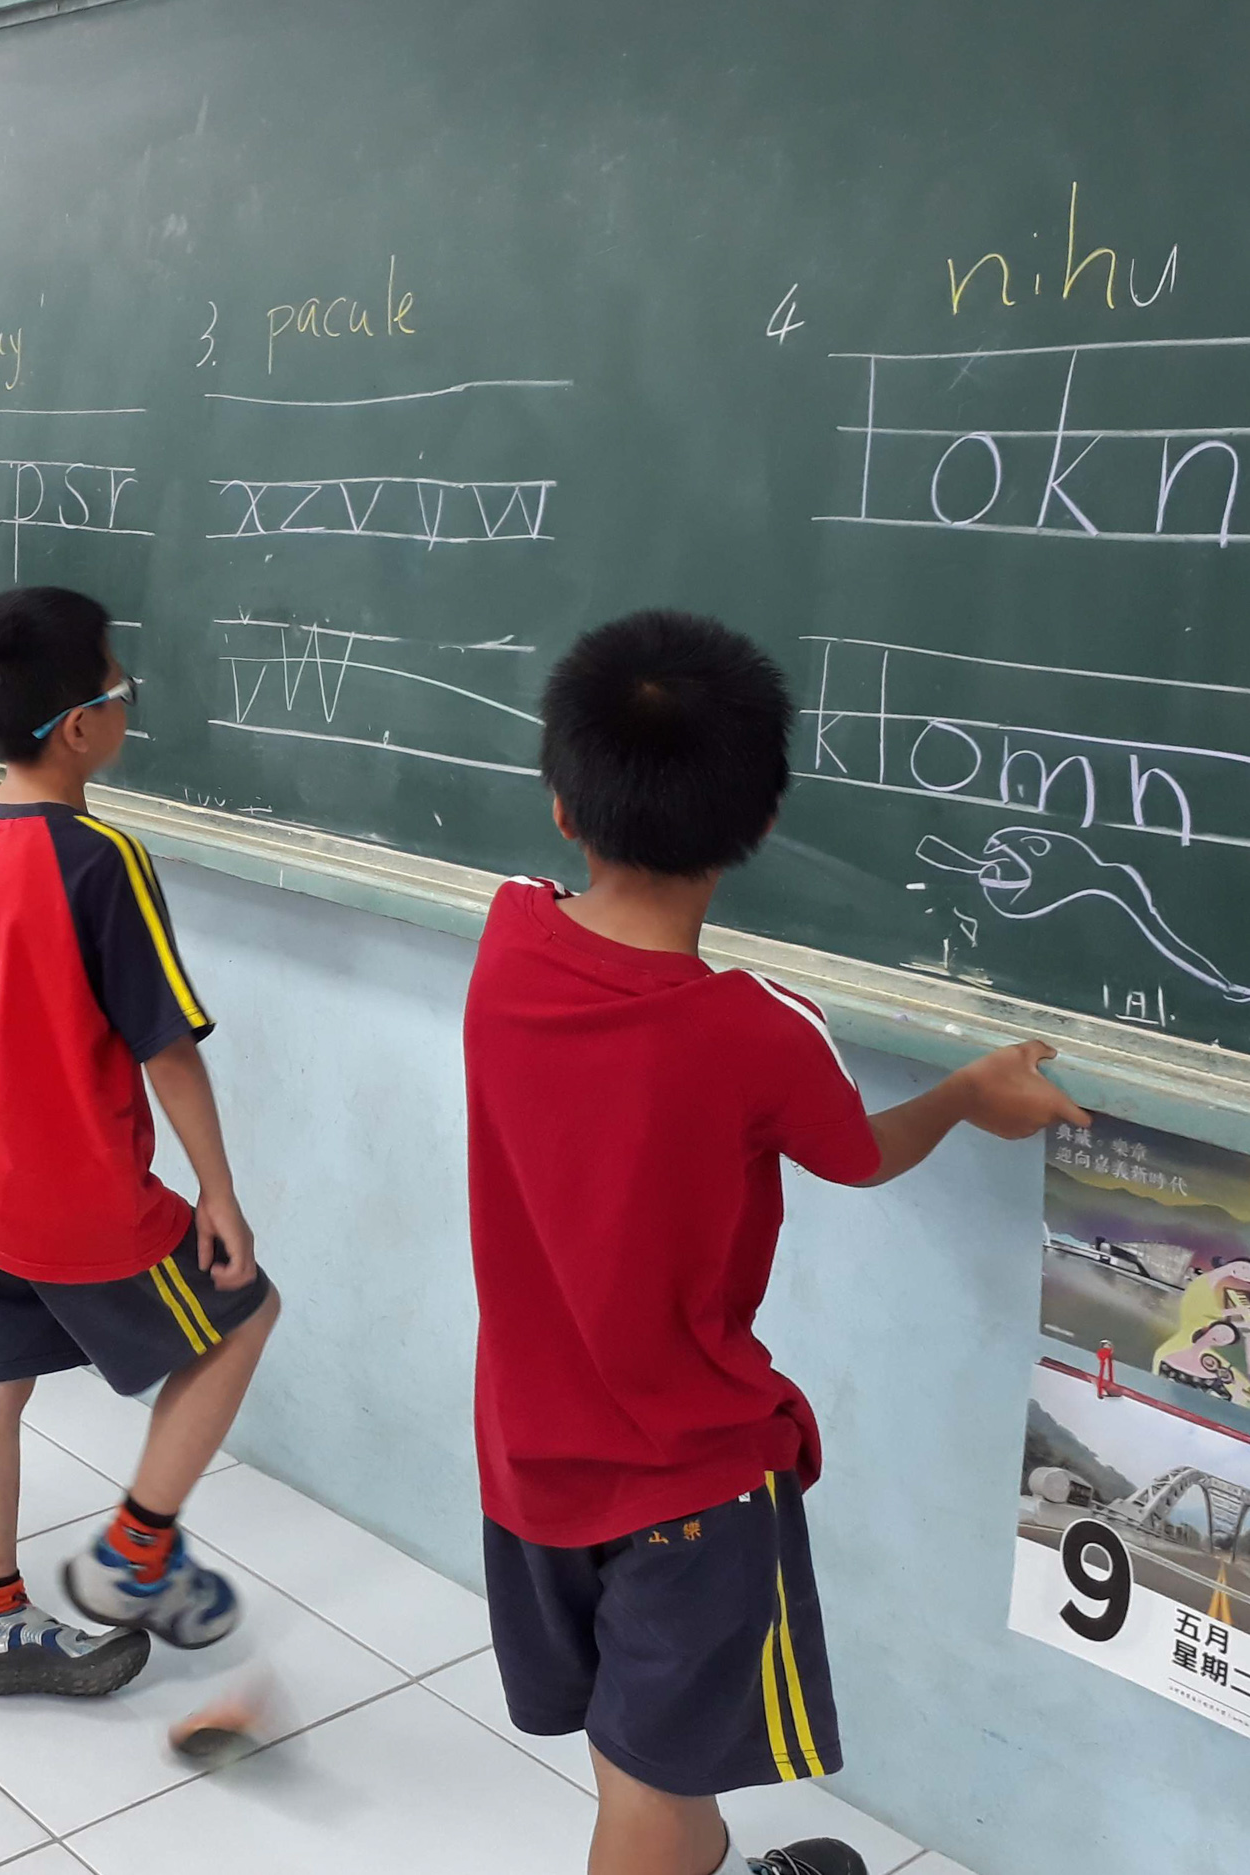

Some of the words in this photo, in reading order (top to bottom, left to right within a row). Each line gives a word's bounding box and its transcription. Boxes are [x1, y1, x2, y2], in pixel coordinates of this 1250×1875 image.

[266, 254, 416, 375] pacule
[766, 283, 805, 345] 4
[947, 181, 1178, 316] nihu
[1058, 1519, 1133, 1642] 9
[1173, 1607, 1229, 1655] 五月
